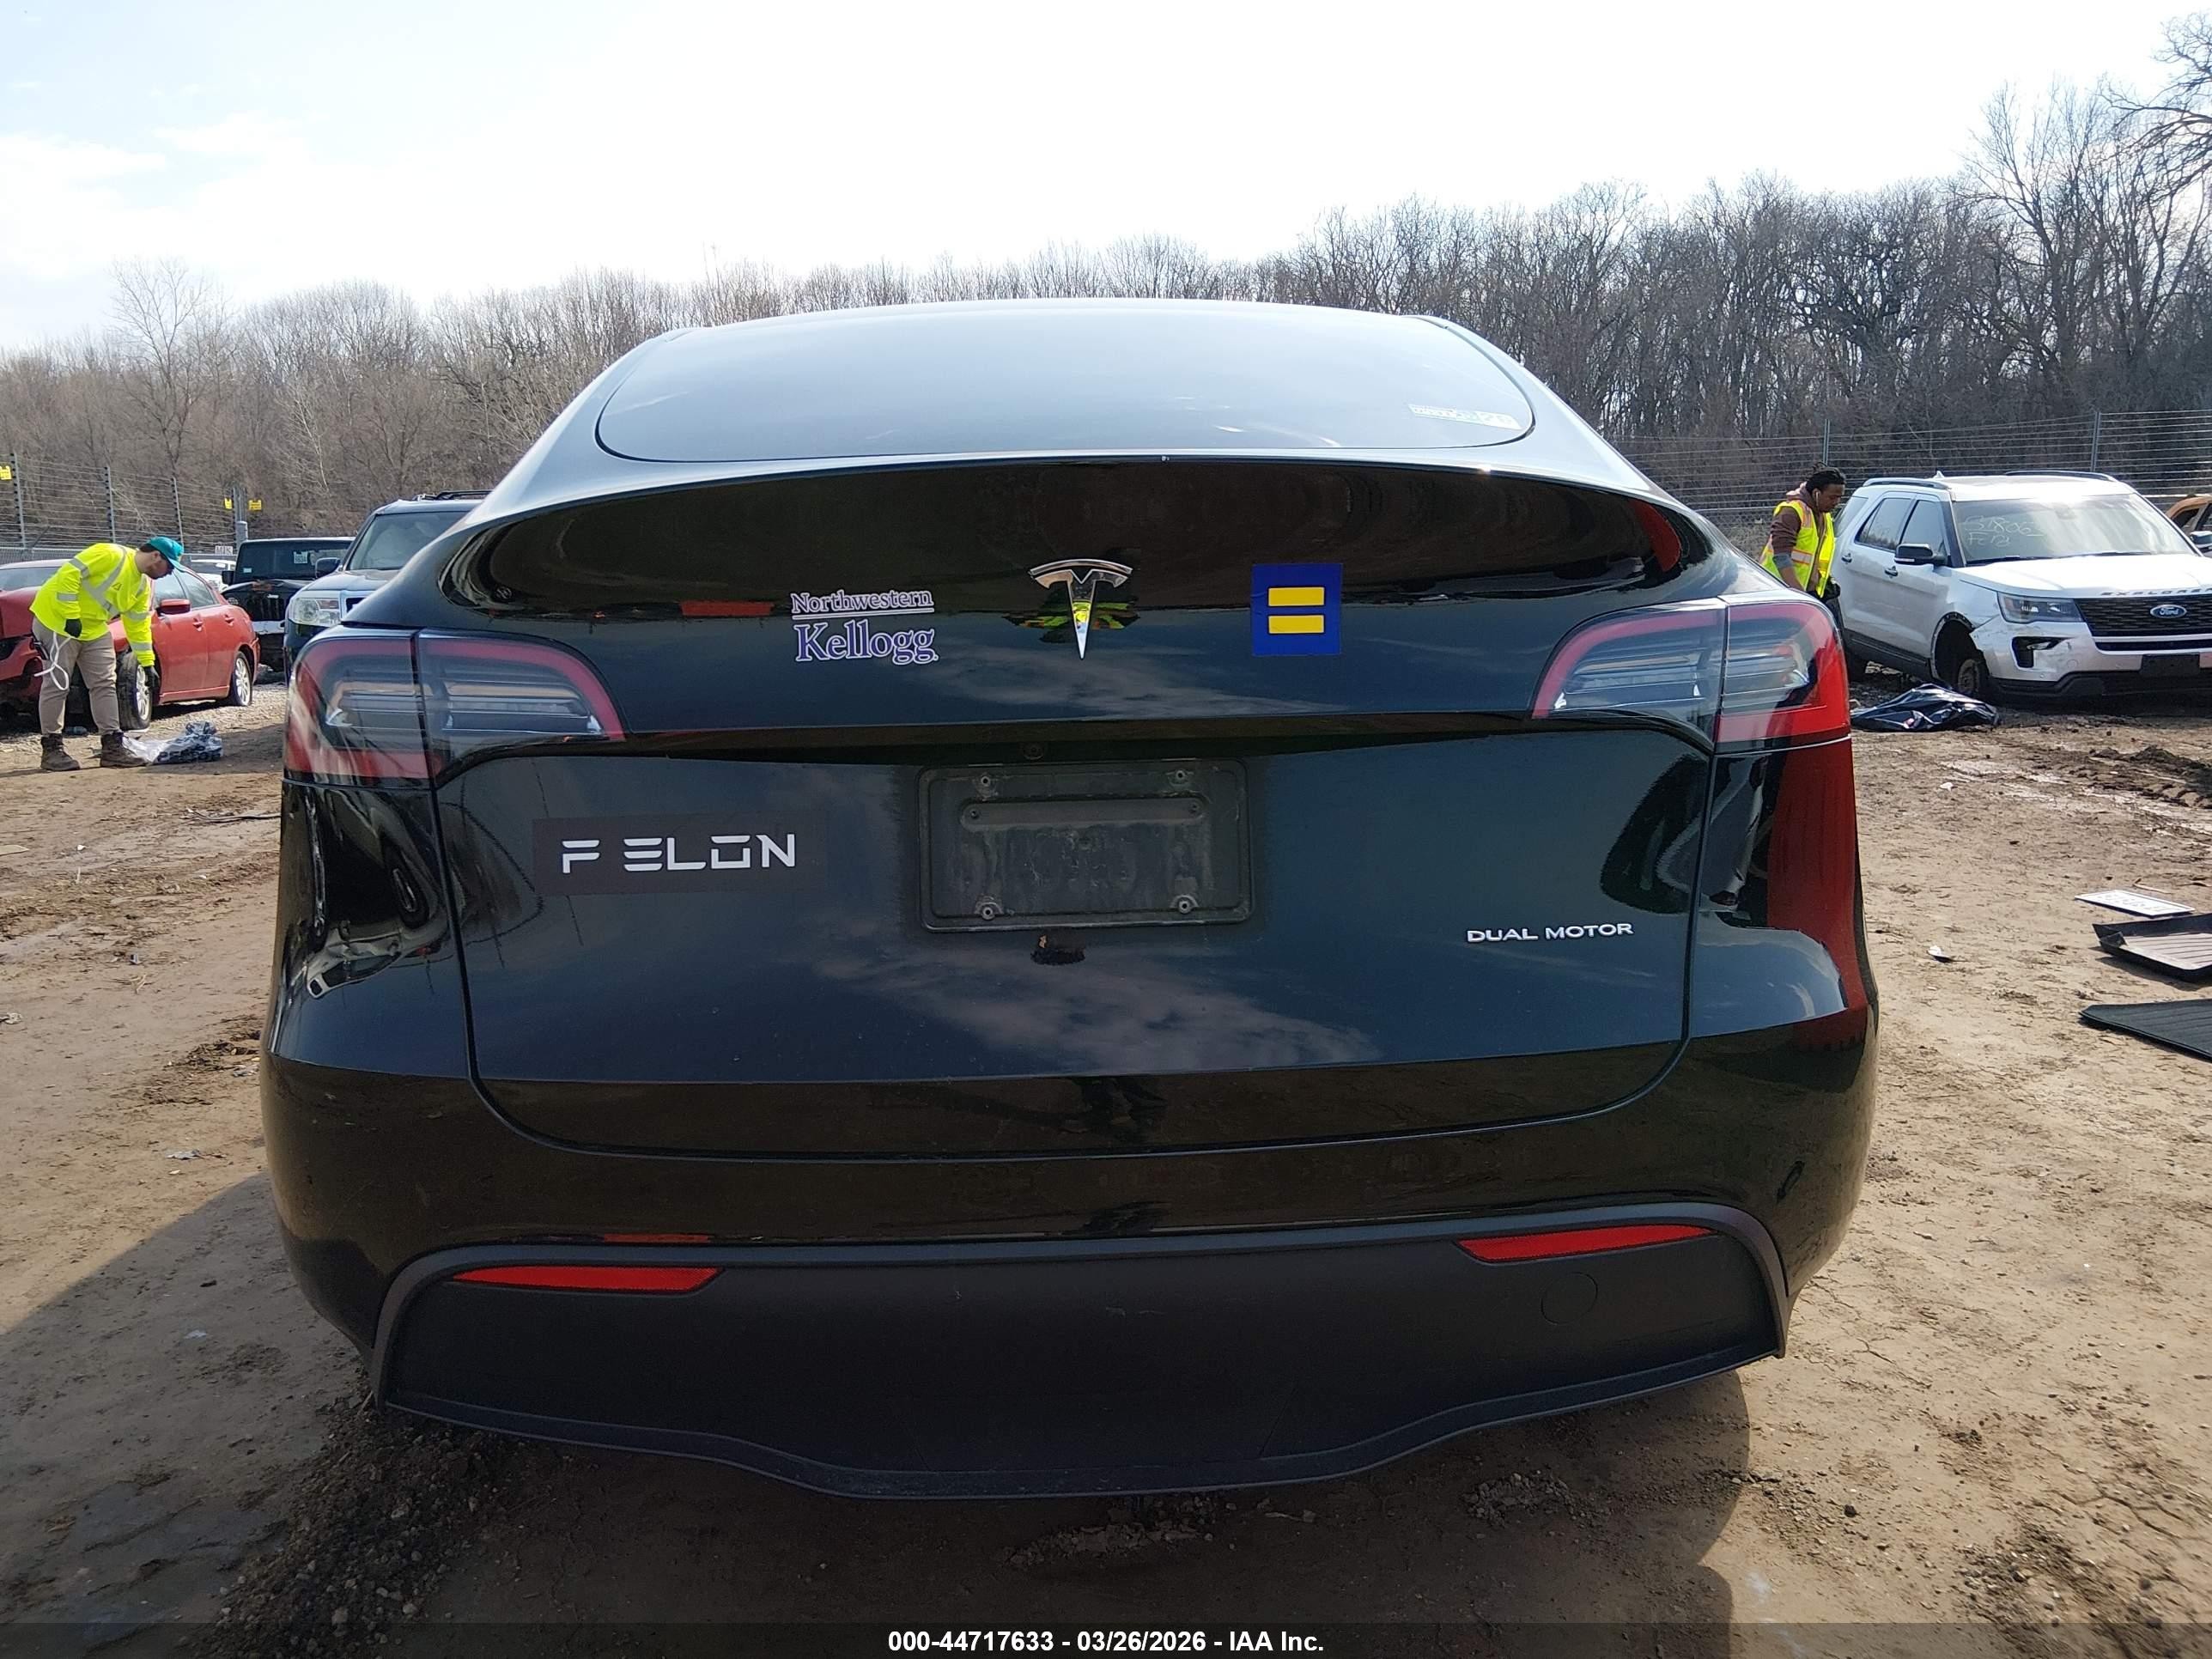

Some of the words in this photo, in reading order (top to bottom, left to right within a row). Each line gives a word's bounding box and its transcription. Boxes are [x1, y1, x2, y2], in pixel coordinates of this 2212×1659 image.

[790, 590, 934, 613] Northwestern
[562, 840, 600, 873] F
[623, 833, 796, 872] ELON
[1467, 929, 1539, 942] DUAL
[1545, 923, 1634, 939] MOTOR
